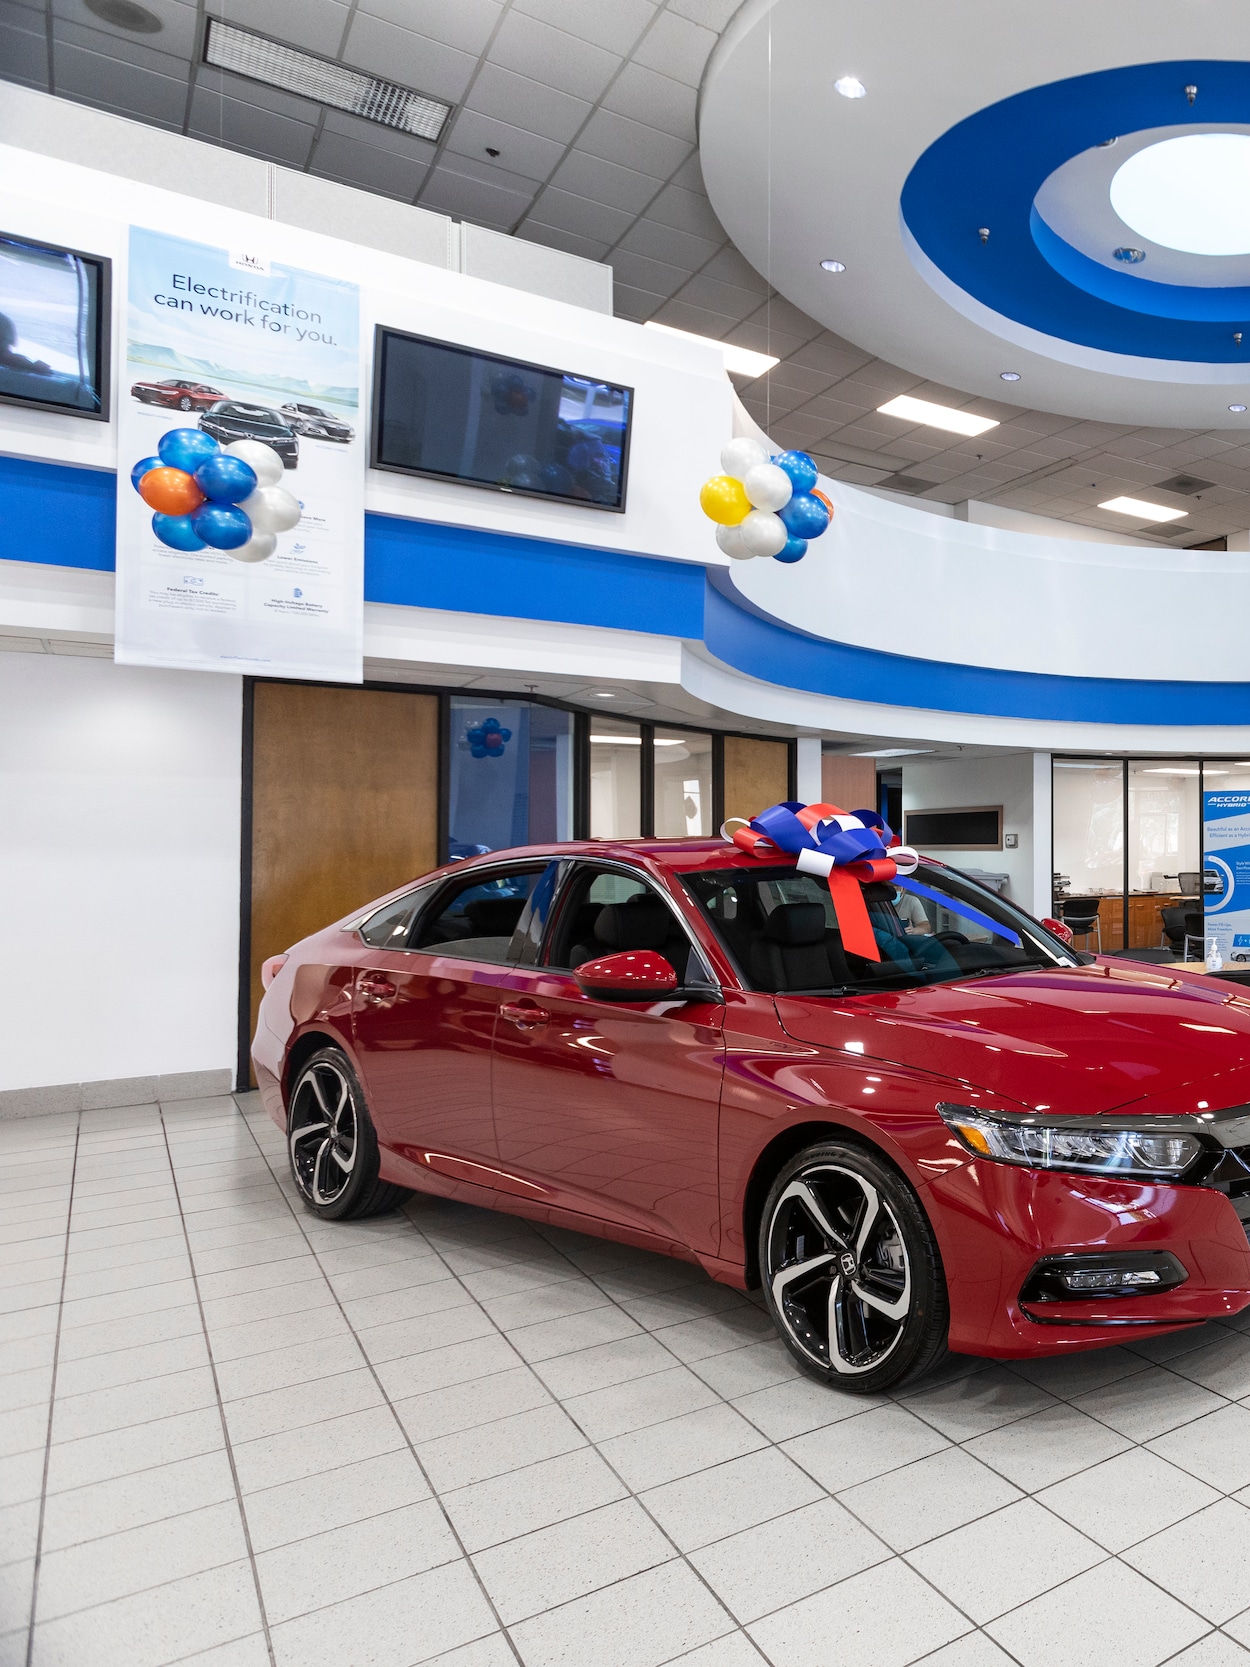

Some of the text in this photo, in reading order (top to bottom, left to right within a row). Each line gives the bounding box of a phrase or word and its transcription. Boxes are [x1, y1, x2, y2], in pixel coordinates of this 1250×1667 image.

[153, 293, 338, 346] can work for you.
[172, 273, 322, 324] Electrification
